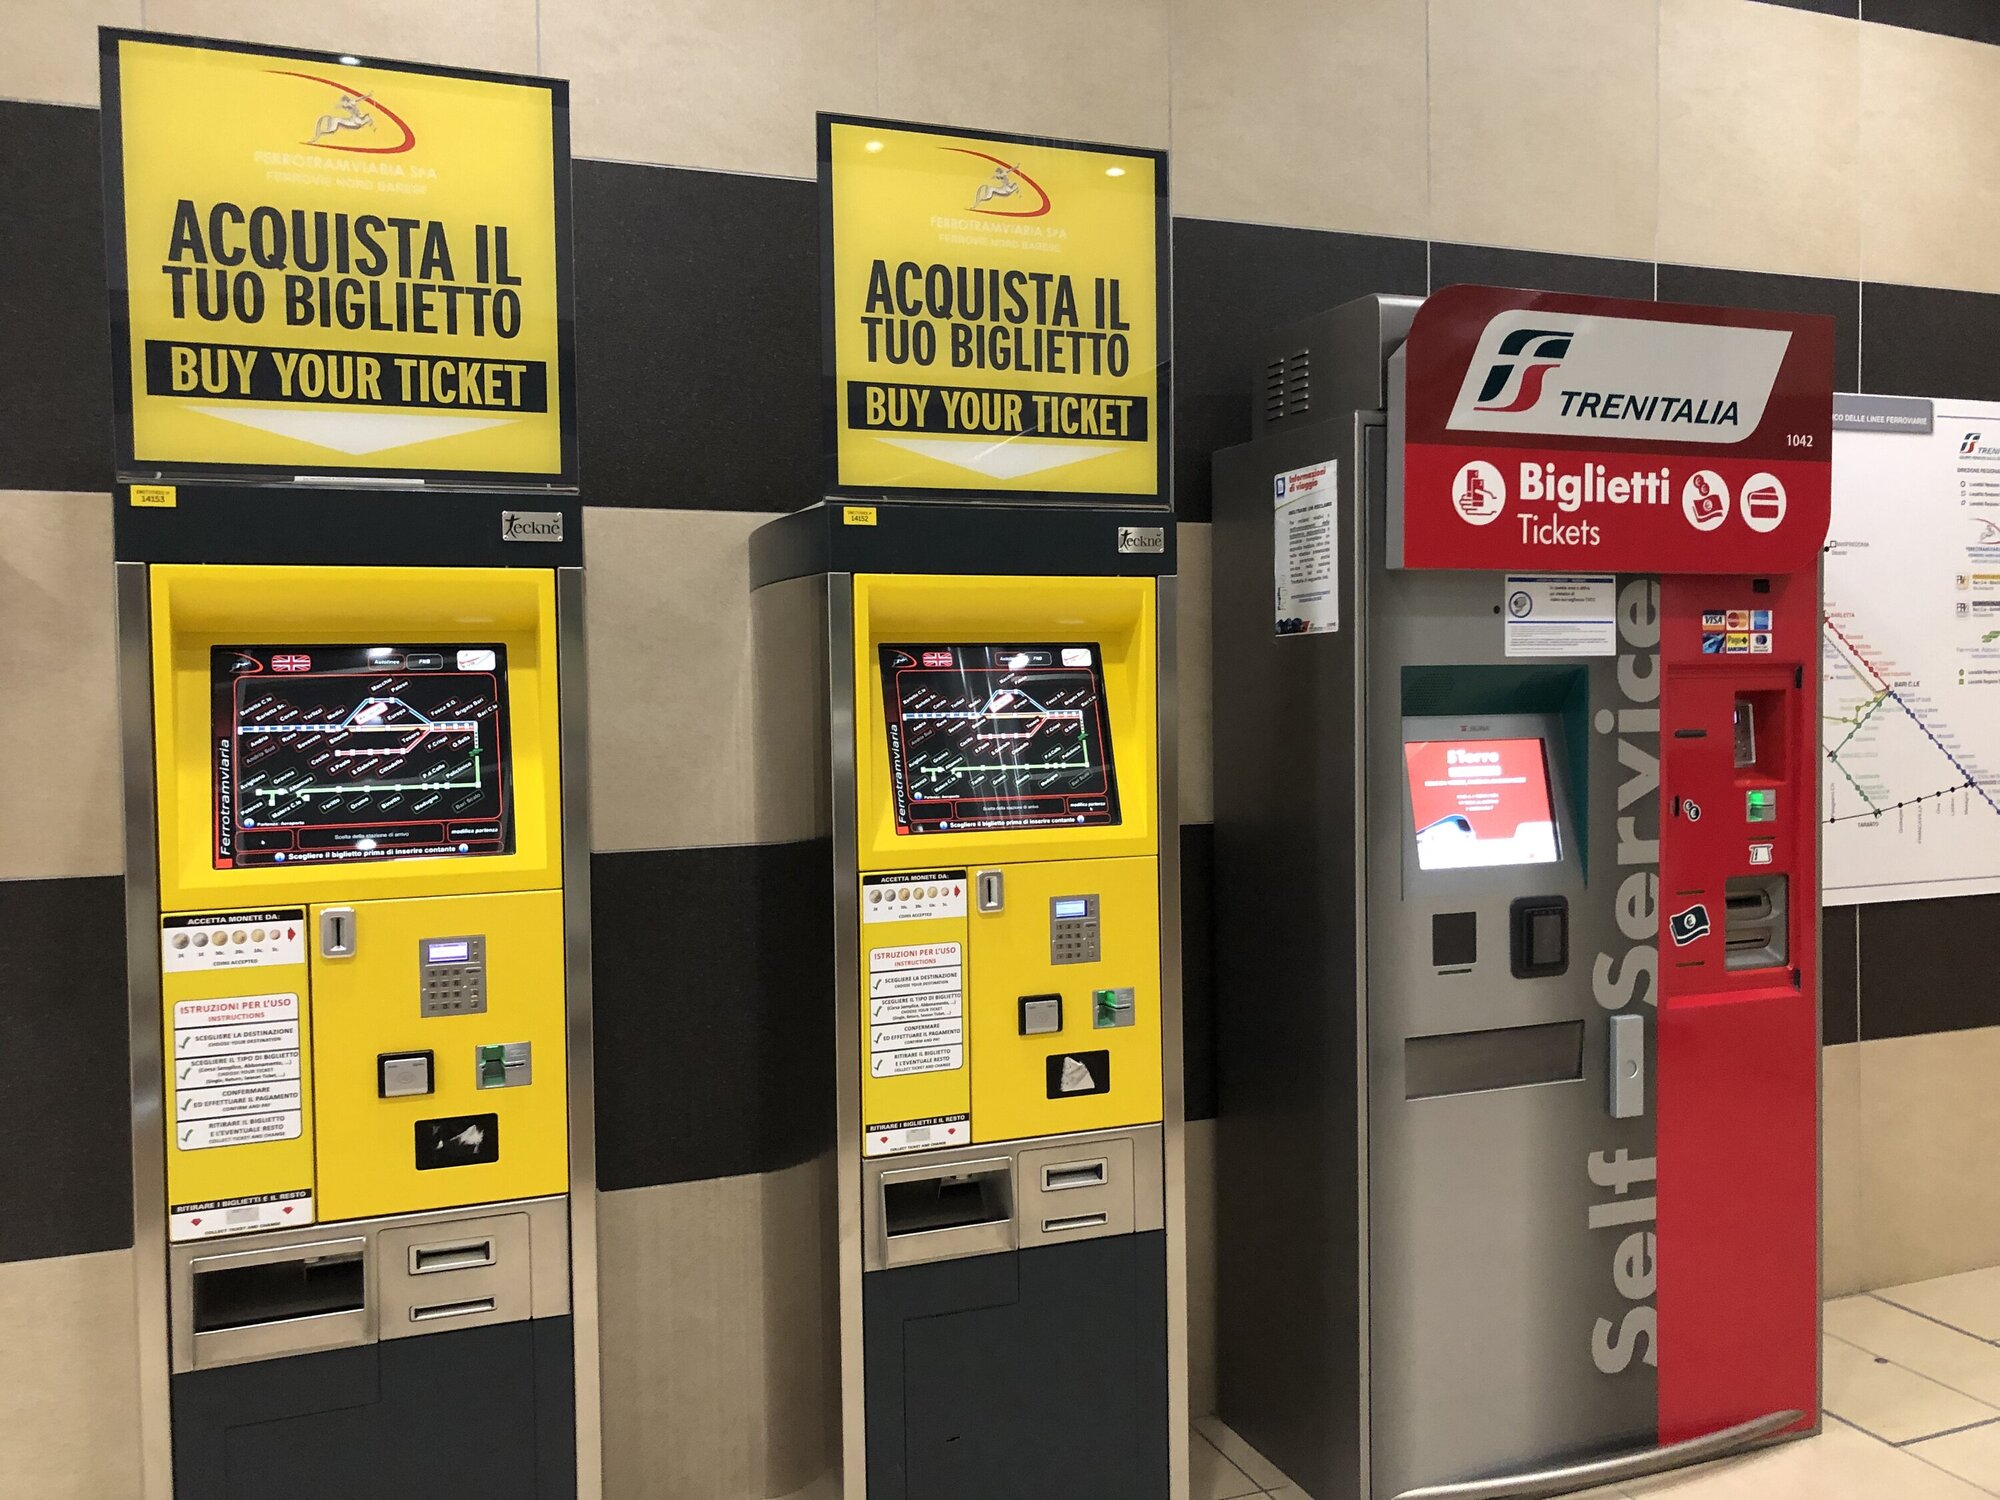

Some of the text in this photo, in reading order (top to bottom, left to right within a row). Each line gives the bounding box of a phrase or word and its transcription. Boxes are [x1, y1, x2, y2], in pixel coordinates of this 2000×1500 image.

[254, 150, 405, 178] FERROTRAMVIARIA
[930, 216, 1042, 237] FERROTRAMVIARIA
[168, 198, 521, 286] ACQUISTA IL
[162, 265, 522, 339] TUO BIGLIETTO
[865, 259, 1130, 330] ACQUISTA IL
[861, 316, 1129, 377] TUO BIGLIETTO
[171, 346, 527, 407] BUY YOUR TICKET
[865, 386, 1133, 436] BUY YOUR TICKET
[1560, 391, 1739, 426] TRENITALIA
[1845, 414, 1865, 422] DELLE
[1886, 417, 1927, 425] FERROVIARIE
[1786, 434, 1813, 448] 1042
[1289, 466, 1326, 483] Informazioni
[1295, 479, 1318, 493] viaggio
[1519, 462, 1670, 512] Biglietti
[141, 495, 165, 503] 14153
[1517, 513, 1600, 546] Tickets
[1705, 616, 1723, 624] VISA
[890, 725, 907, 823] Ferrotramviaria
[219, 739, 231, 855] Ferrotramviaria
[1592, 576, 1661, 1008] Service
[288, 852, 323, 862] Scegliere
[332, 851, 362, 860] biglietto
[363, 850, 384, 858] prima
[395, 847, 423, 855] inserire
[424, 846, 456, 854] contante
[187, 917, 227, 925] ACCETTA
[874, 950, 918, 960] ISTRUZIONI
[935, 946, 956, 955] L'USO
[894, 958, 936, 967] INSTRUCTIONS
[885, 976, 912, 984] SCEGLIERE
[920, 972, 957, 980] DESTINAZIONE
[180, 998, 291, 1014] ISTRUZIONI PER L'USO
[882, 997, 908, 1005] SCEGLIERE
[935, 992, 961, 1000] BIGLIETTO
[208, 1012, 265, 1022] INSTRUCTIONS
[195, 1033, 231, 1041] SCEGLIERE
[243, 1028, 293, 1038] DESTINAZIONE
[891, 1032, 922, 1040] EFFETTUARE
[928, 1028, 960, 1036] PAGAMENTO
[904, 1023, 940, 1032] CONFERMARE
[191, 1057, 227, 1067] SCEGLIERE
[264, 1051, 298, 1060] BIGLIETTO
[894, 1052, 918, 1060] RITIRARE
[924, 1048, 951, 1057] BIGLIETTO
[204, 1098, 246, 1107] EFFETTUARE
[255, 1092, 298, 1102] PAGAMENTO
[222, 1087, 270, 1097] CONFERMARE
[208, 1120, 240, 1129] RITIRARE
[249, 1115, 285, 1125] BIGLIETTO
[870, 1123, 898, 1131] RITIRARE
[903, 1119, 932, 1127] BIGLIETTI
[945, 1114, 965, 1122] RESTO
[177, 1203, 214, 1213] RITIRARE
[222, 1197, 261, 1207] BIGLIETTI
[279, 1191, 306, 1201] RESTO
[1588, 1147, 1659, 1374] Self
